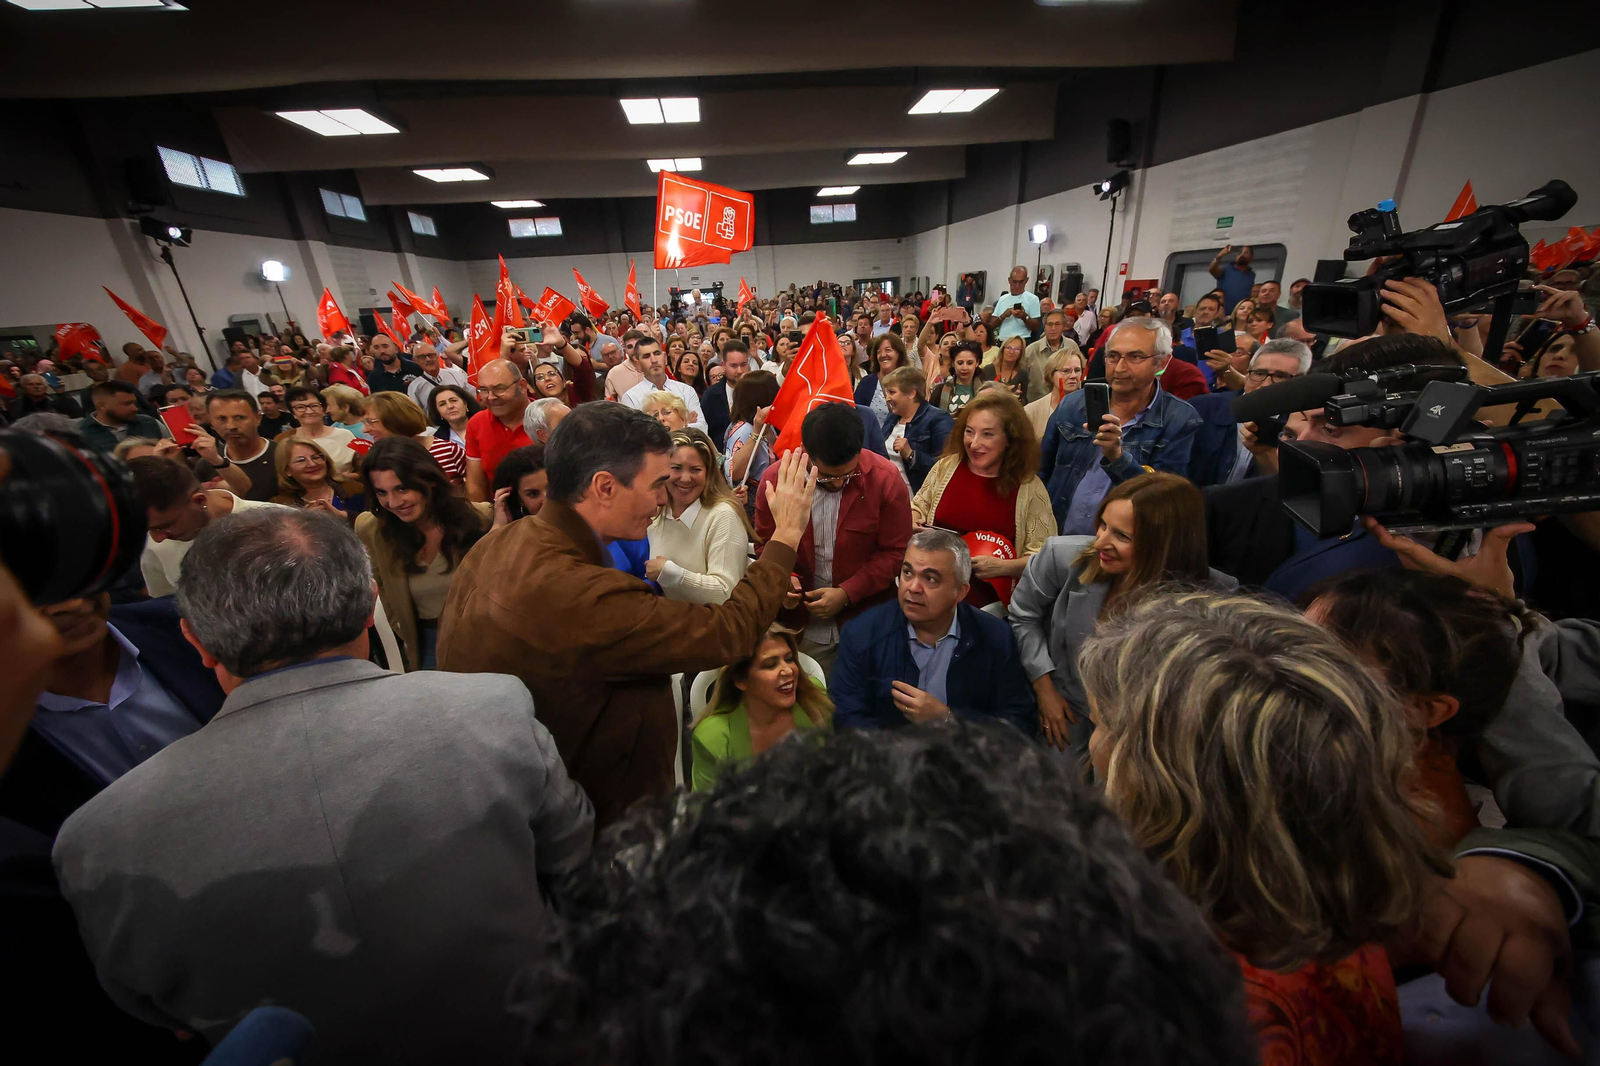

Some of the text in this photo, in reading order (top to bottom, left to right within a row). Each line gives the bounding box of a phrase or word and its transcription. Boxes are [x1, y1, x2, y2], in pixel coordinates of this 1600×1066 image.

[665, 205, 702, 230] PSOE
[1430, 405, 1446, 415] 4K
[1526, 437, 1568, 445] Panasonic
[975, 532, 1014, 558] Vota lo que
